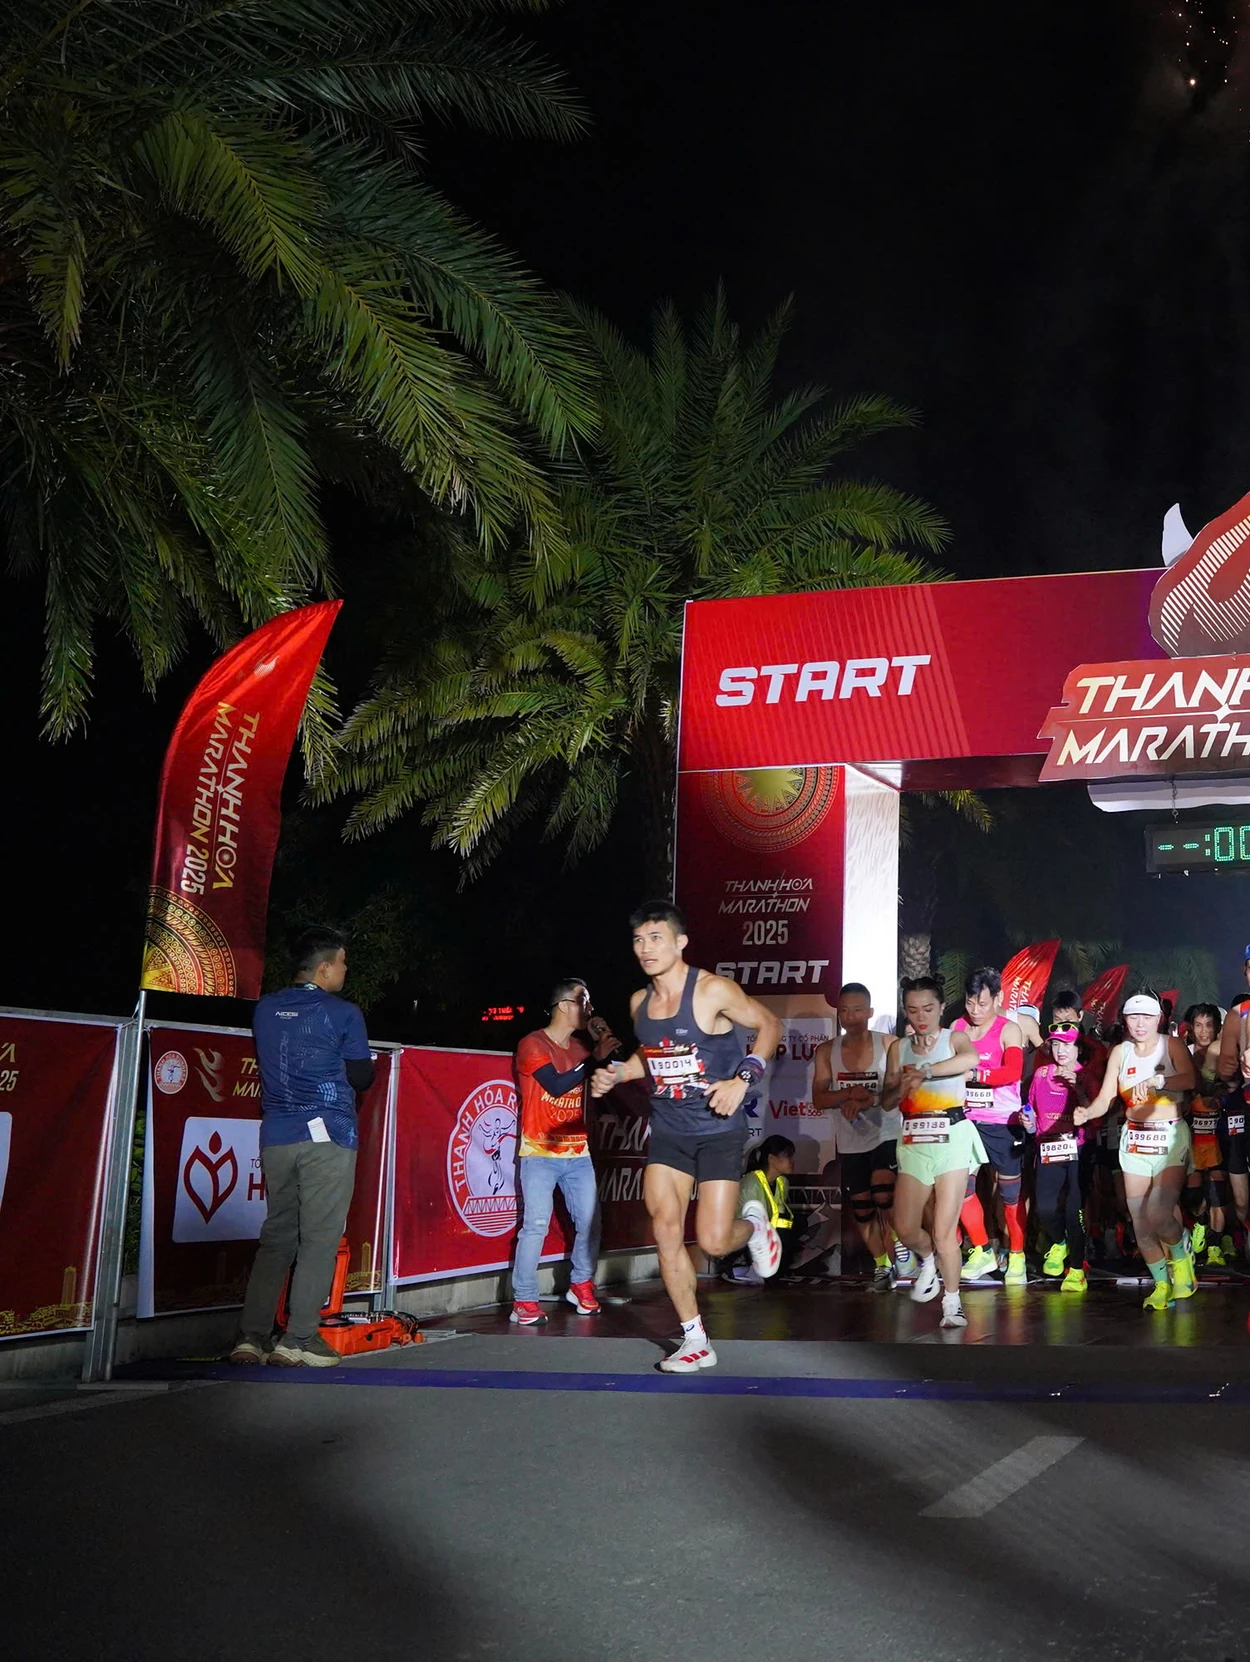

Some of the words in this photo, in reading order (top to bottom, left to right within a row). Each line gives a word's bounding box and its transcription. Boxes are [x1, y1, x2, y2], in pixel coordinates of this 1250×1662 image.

[714, 654, 932, 707] START
[189, 702, 237, 844] MARATHON
[221, 712, 260, 822] THANH
[180, 844, 210, 896] 2025
[725, 879, 779, 893] THANH
[718, 898, 811, 914] MARATHON
[742, 919, 789, 946] 2025
[715, 960, 830, 985] START
[0, 1070, 19, 1092] 25
[474, 1086, 503, 1113] HÓA
[768, 1100, 806, 1119] Viet
[453, 1111, 475, 1193] THANH
